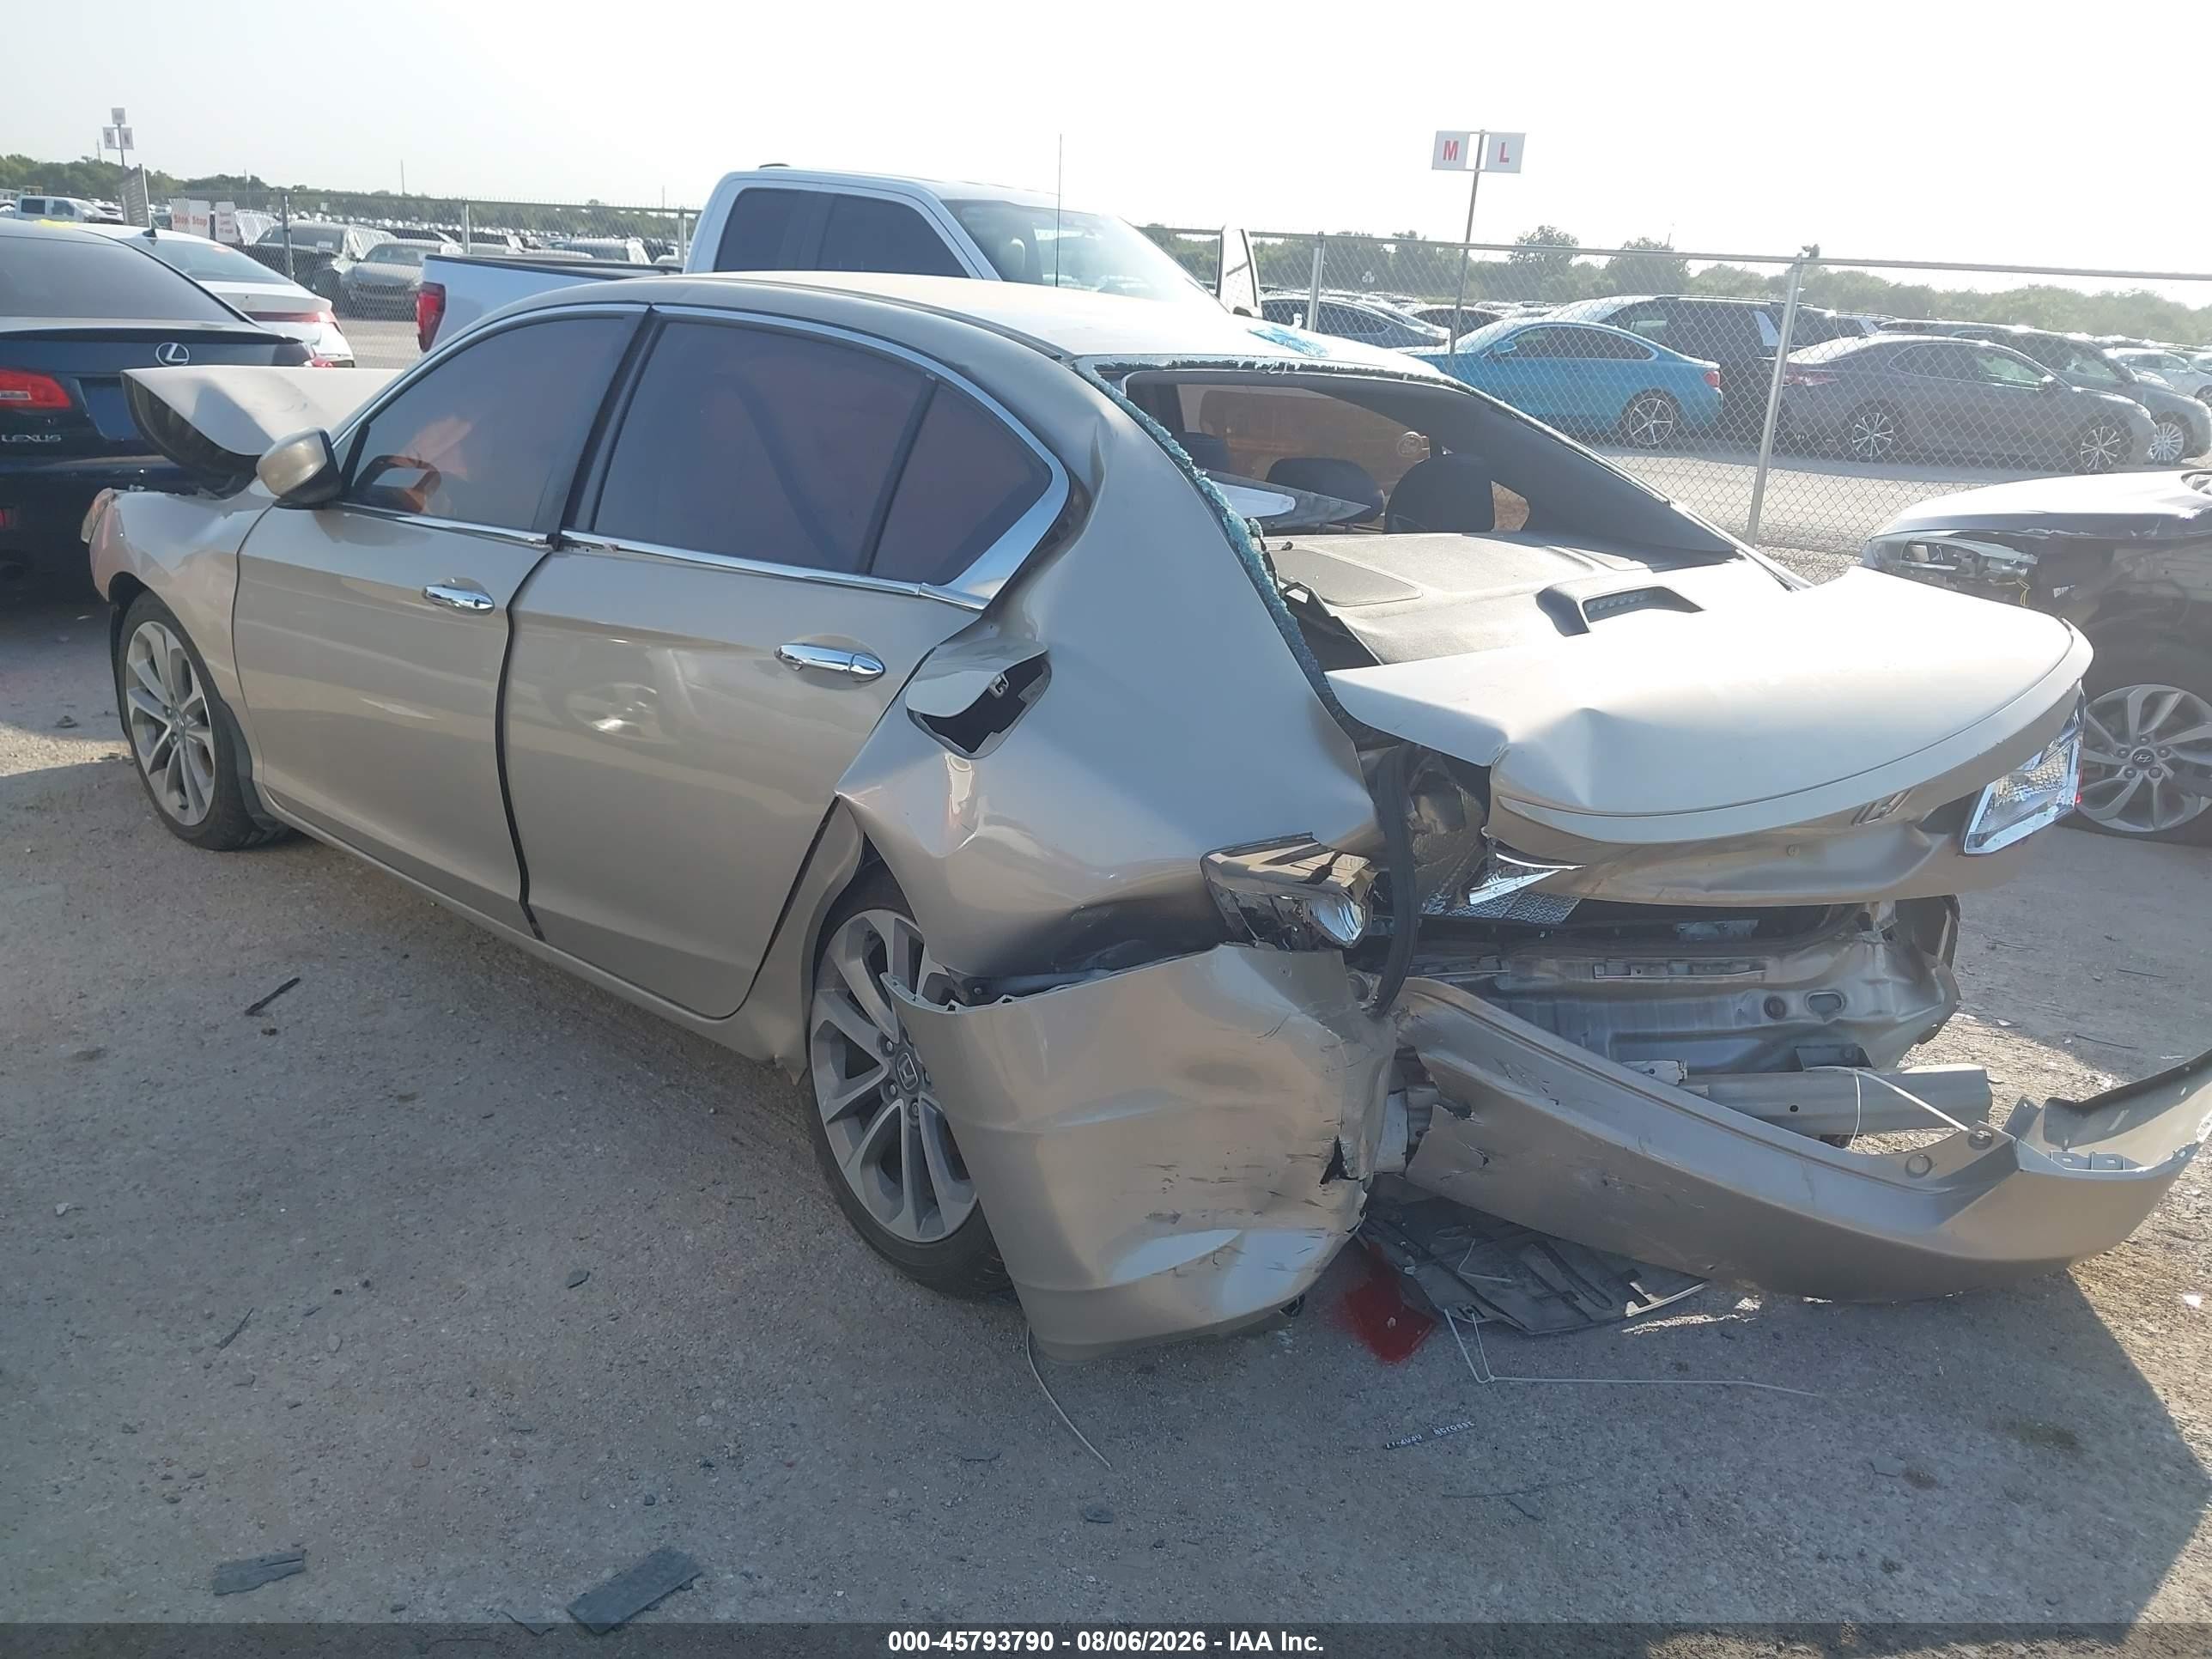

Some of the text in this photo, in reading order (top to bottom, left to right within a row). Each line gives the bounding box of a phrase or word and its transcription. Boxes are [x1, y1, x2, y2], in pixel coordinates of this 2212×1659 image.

[1443, 140, 1459, 161] M
[1498, 142, 1510, 163] L
[191, 216, 208, 228] Stop
[1, 434, 62, 443] LEXUS
